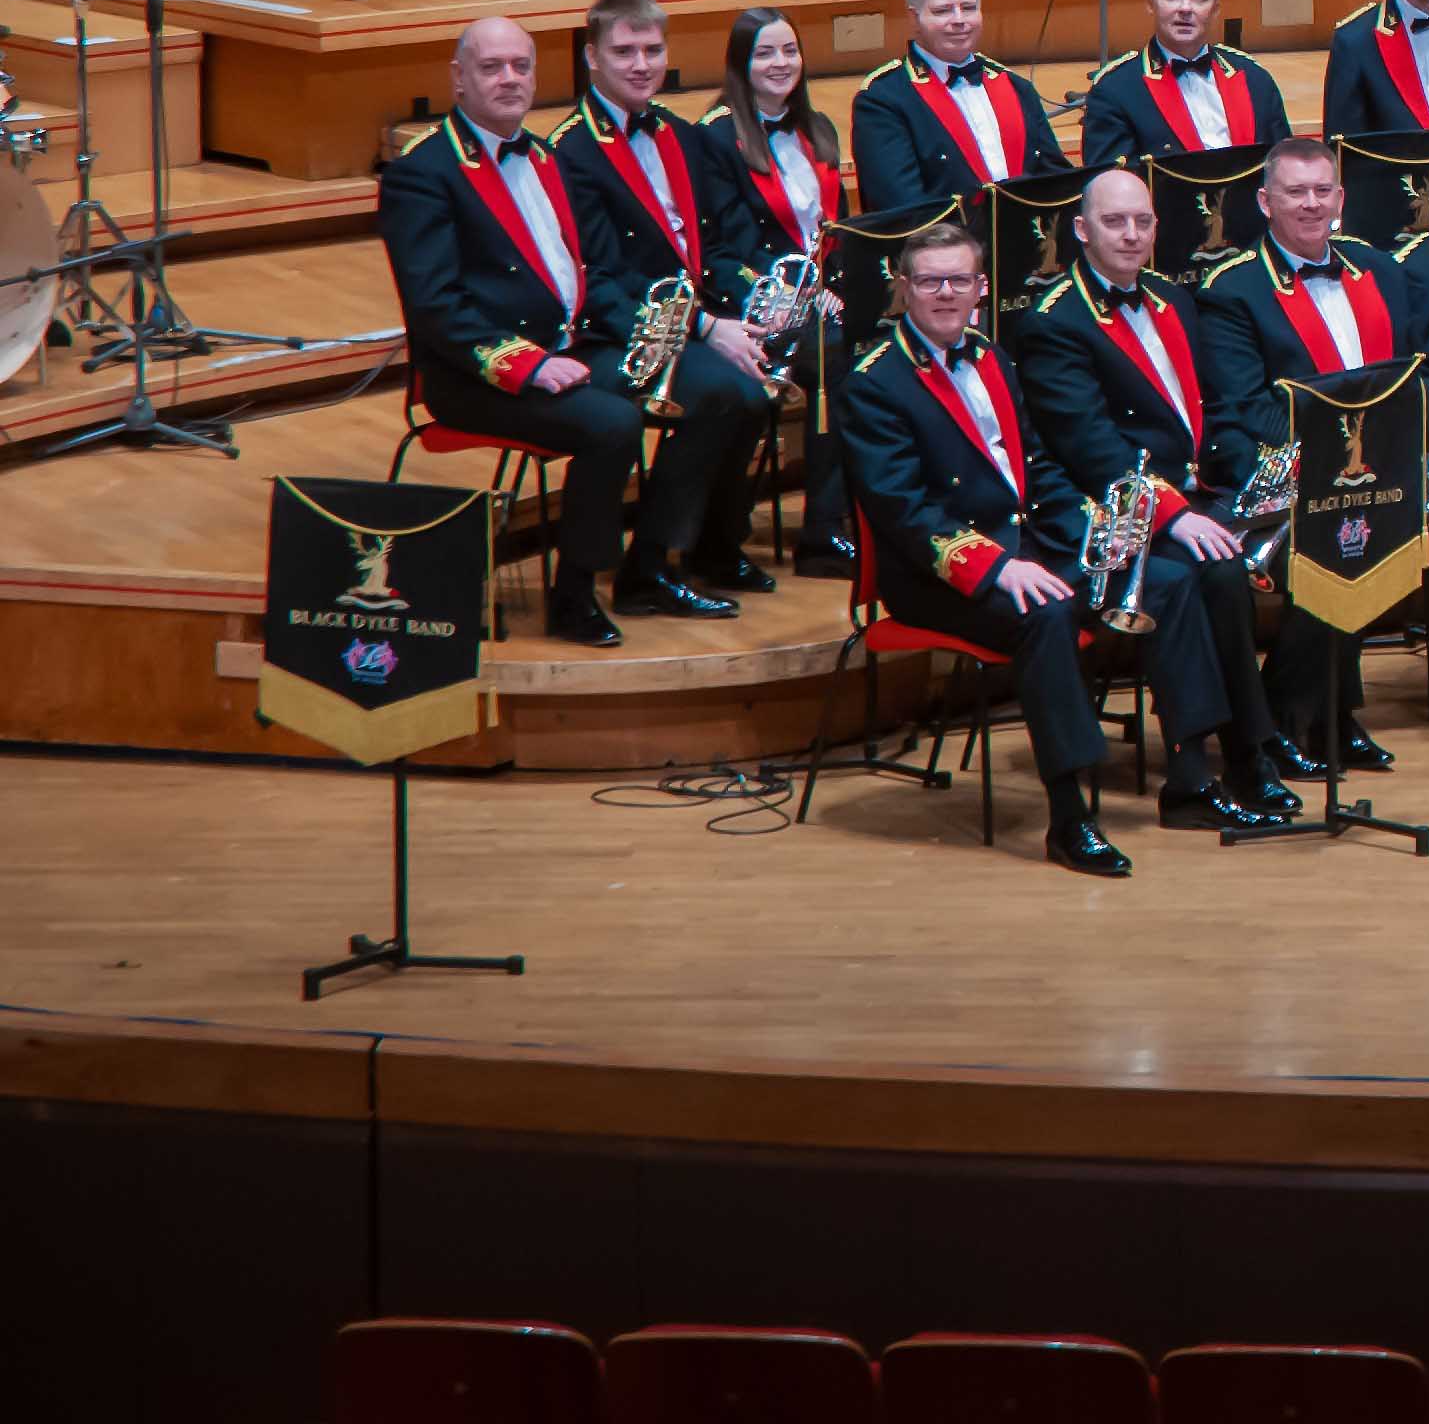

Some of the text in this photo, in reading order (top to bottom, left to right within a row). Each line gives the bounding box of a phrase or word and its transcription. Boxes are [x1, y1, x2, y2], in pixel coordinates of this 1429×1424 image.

[1308, 488, 1402, 513] BLACK DYKE BAND
[289, 610, 455, 637] BLACK DYKE BAND
